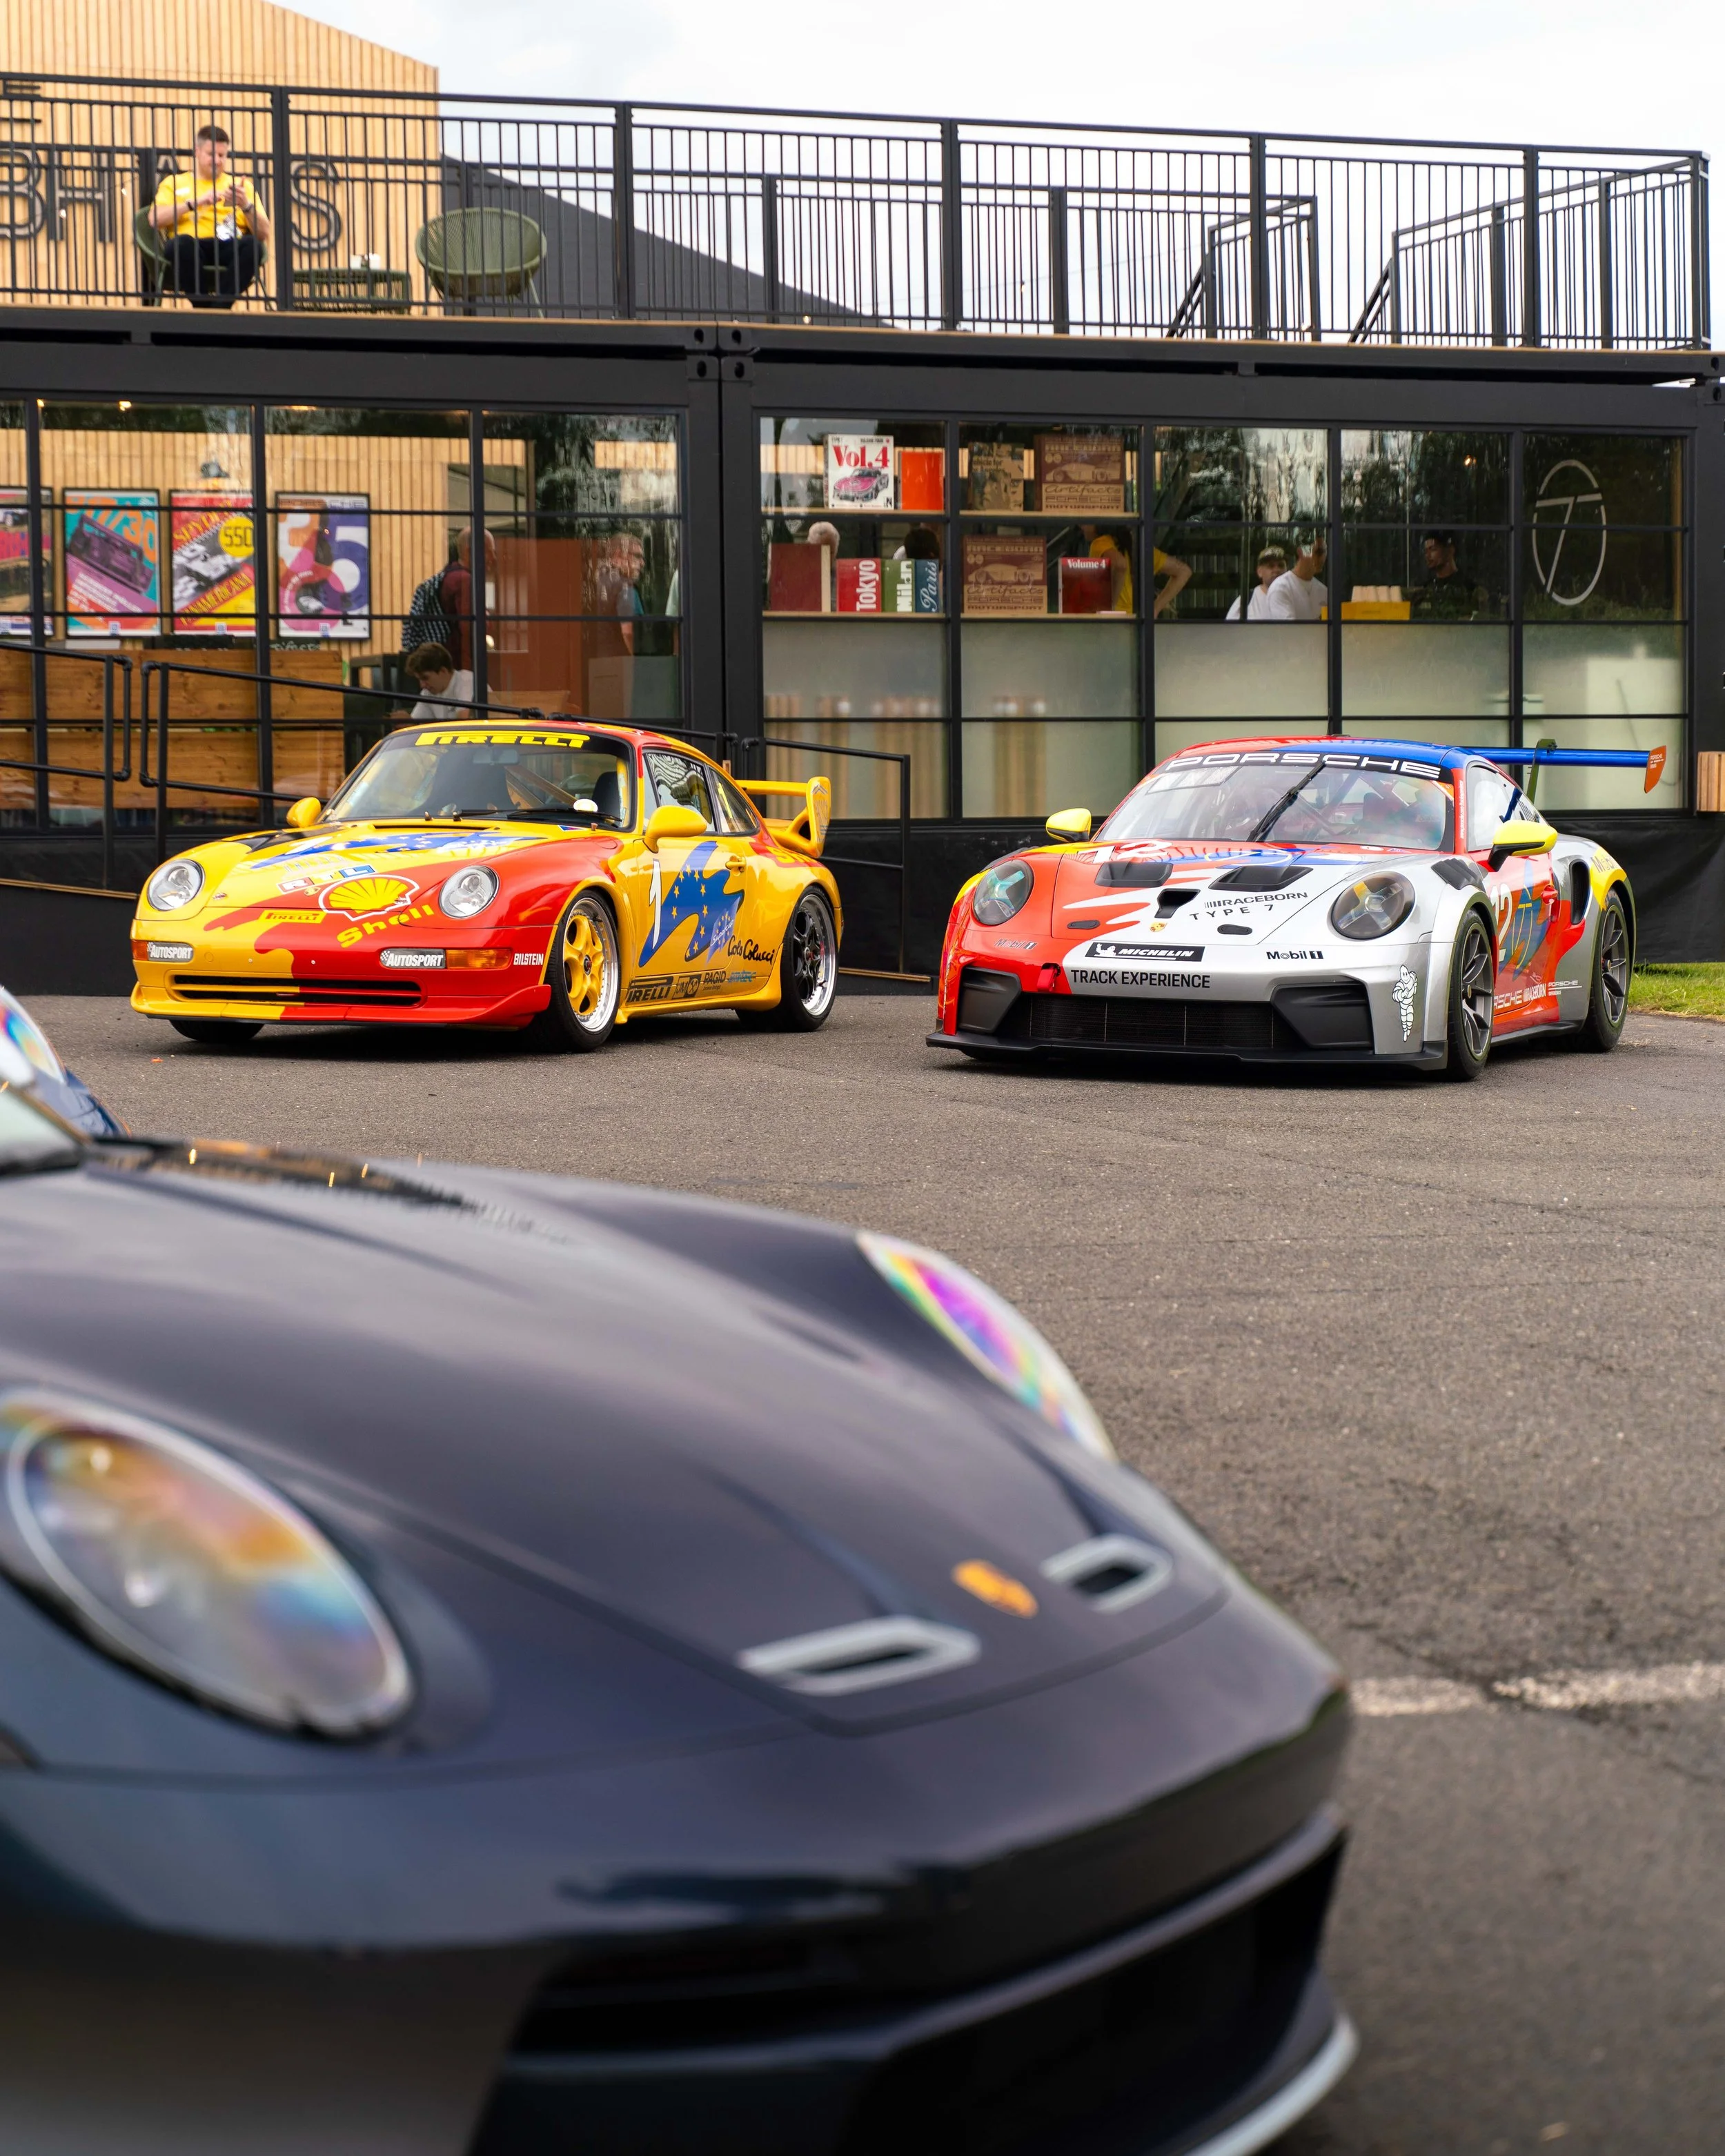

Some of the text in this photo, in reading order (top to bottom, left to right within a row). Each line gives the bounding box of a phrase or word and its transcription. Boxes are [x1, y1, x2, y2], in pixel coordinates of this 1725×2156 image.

[832, 444, 890, 468] Vol.4
[1067, 558, 1106, 568] Volume 4
[856, 560, 879, 611] Tokyo
[920, 561, 938, 612] Paris
[415, 730, 590, 749] PIRELLI
[1165, 752, 1441, 779] PORSCHE
[279, 866, 374, 893] RTL
[649, 858, 662, 951] 1
[1222, 892, 1308, 907] RACEBORN
[265, 912, 320, 921] PIRELLI
[1189, 907, 1250, 920] TYPE
[337, 904, 435, 949] Shell
[150, 945, 193, 959] AUTOSPORT
[743, 939, 775, 965] Colucci
[994, 938, 1025, 949] Mobil
[386, 953, 443, 967] AUTOSPORT
[513, 953, 544, 966] BILSTEIN
[1117, 947, 1194, 958] MICHELIN
[1266, 951, 1308, 960] Mobil
[704, 970, 726, 985] PAGID
[1070, 969, 1211, 989] TRACK EXPERIENCE
[625, 976, 673, 1003] PIRELLI
